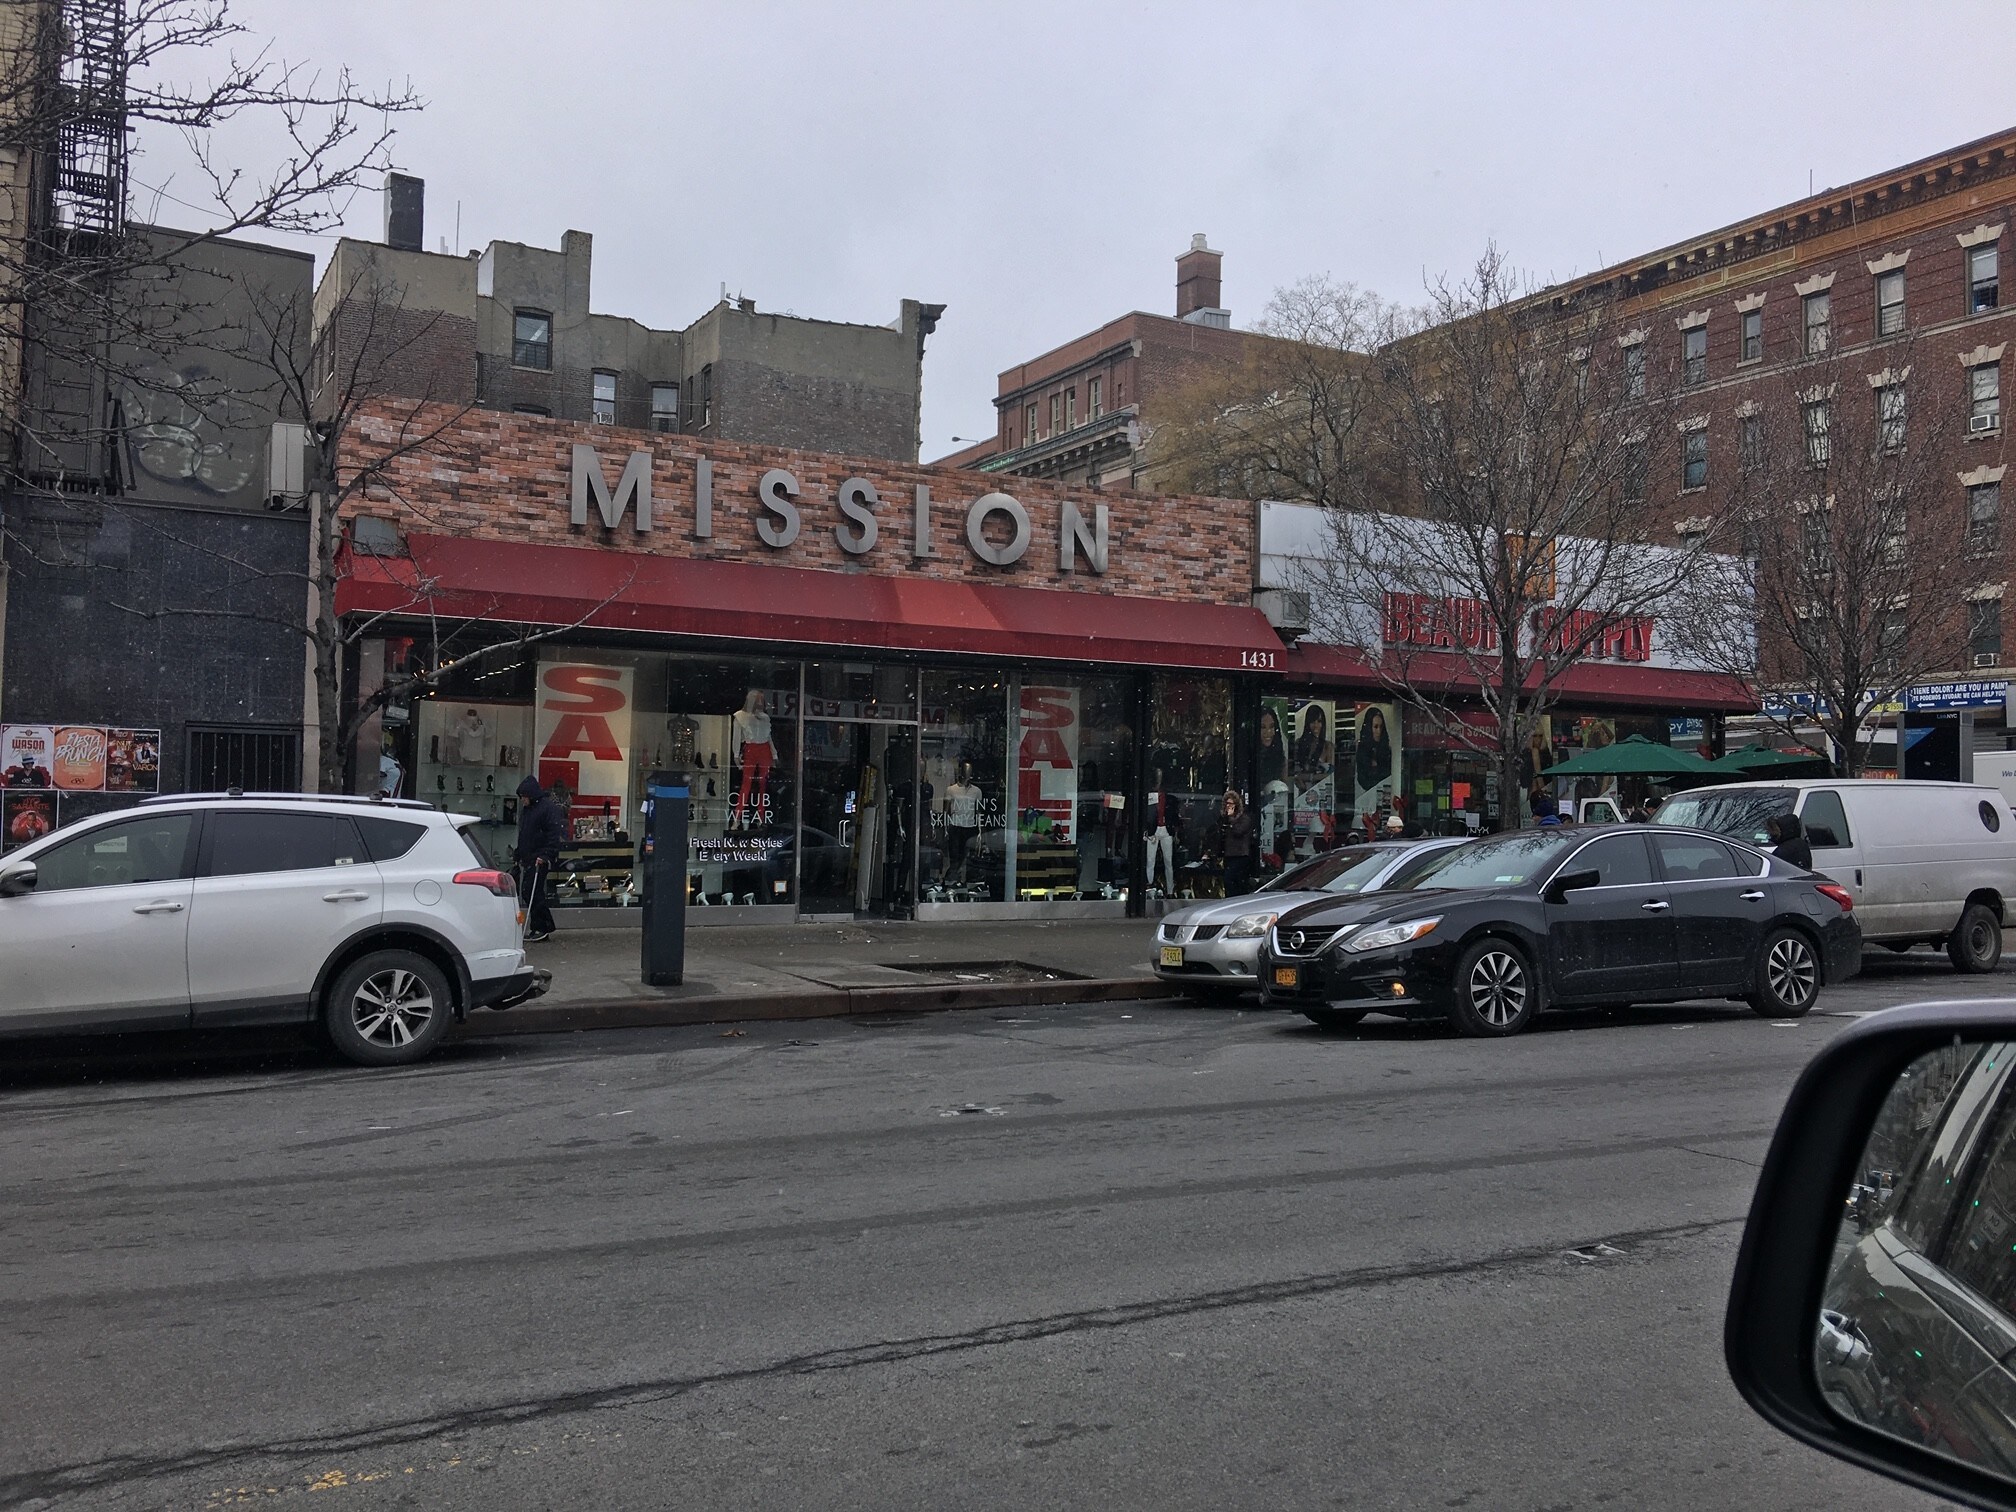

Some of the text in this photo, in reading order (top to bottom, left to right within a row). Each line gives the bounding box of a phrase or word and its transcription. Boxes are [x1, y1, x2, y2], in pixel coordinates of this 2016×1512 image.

[571, 444, 1109, 574] MISSION
[1383, 592, 1526, 650] BEAUT
[1240, 650, 1276, 669] 1431
[1931, 684, 1954, 693] DOLOR?
[1955, 684, 1967, 692] ARE
[1968, 683, 1982, 691] YOU
[1990, 681, 2009, 690] PAIN?
[1920, 693, 1941, 701] PODEMOS
[1411, 722, 1446, 736] BEAUT
[12, 739, 45, 750] WASON
[67, 732, 101, 746] FIESTA
[55, 744, 107, 764] BRUNCH
[727, 792, 771, 807] CLUB
[952, 798, 998, 811] MEN'S
[724, 809, 774, 825] WEAR
[930, 813, 1007, 828] SKINNY JEANS
[1469, 826, 1490, 835] NYX
[689, 837, 784, 851] Fresh Nw Styles
[699, 851, 731, 864] Eery
